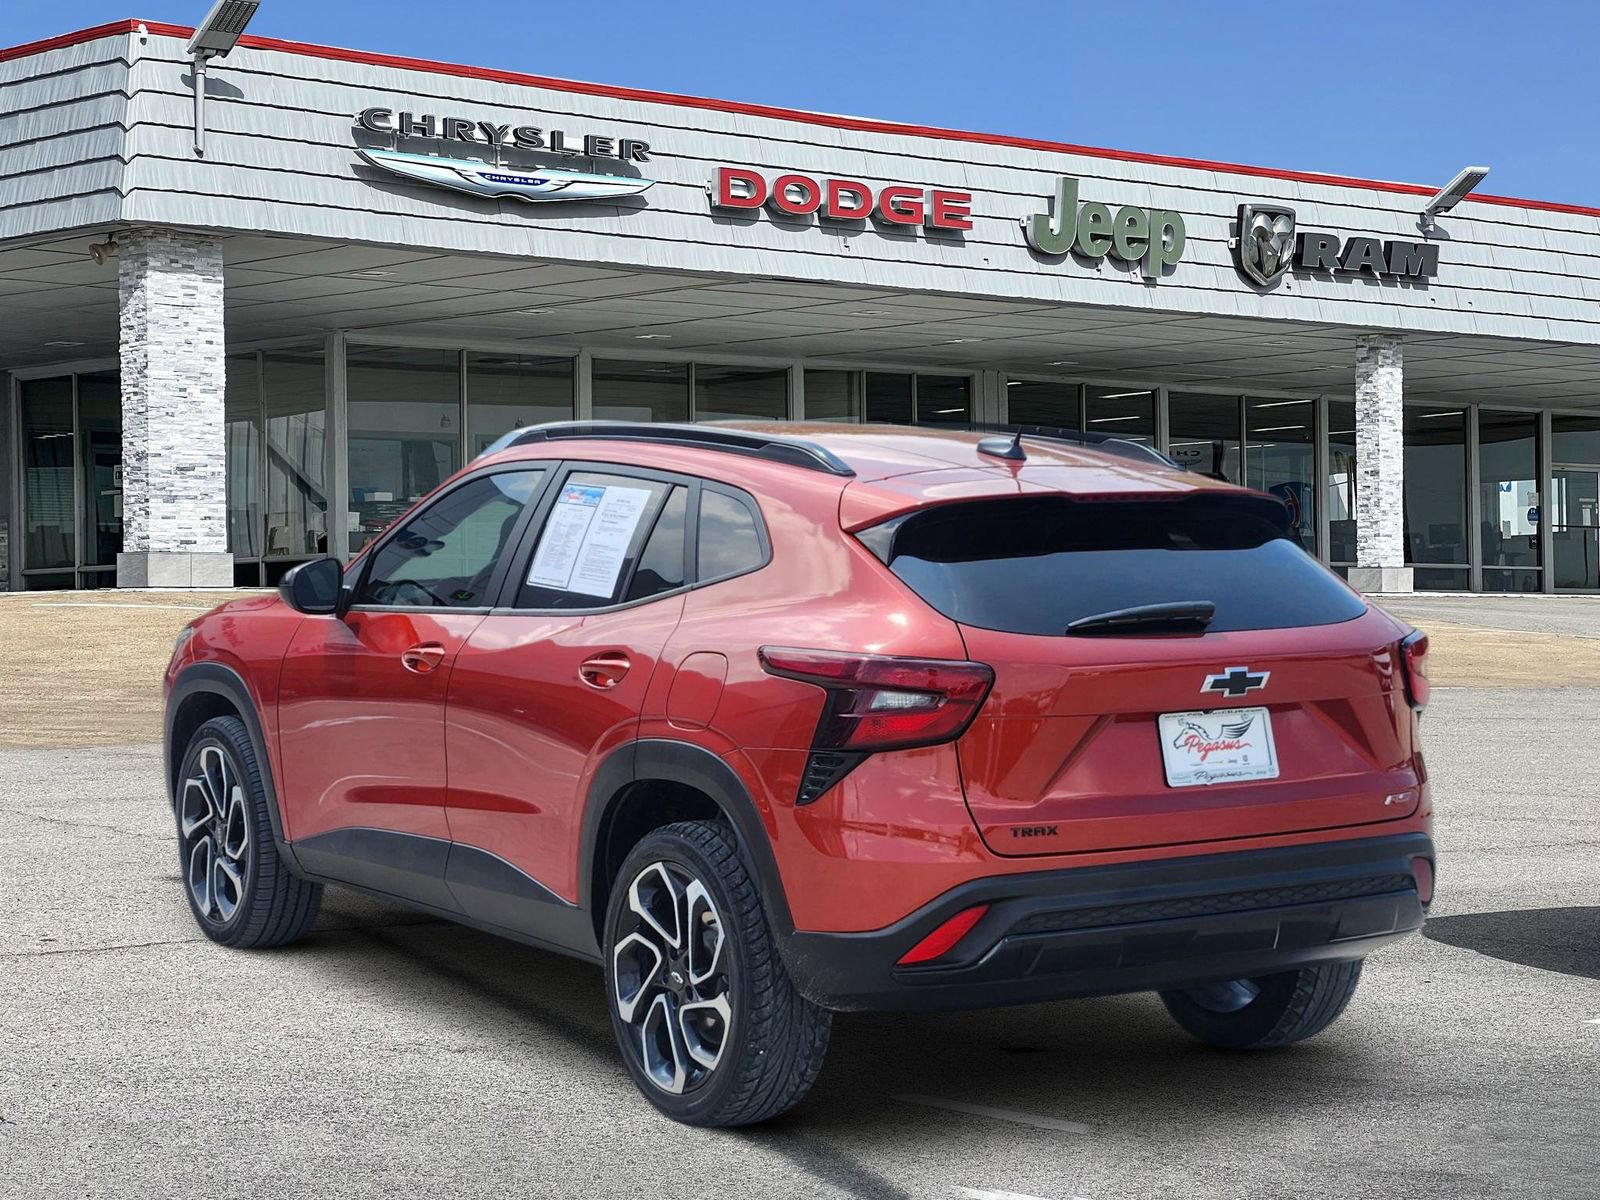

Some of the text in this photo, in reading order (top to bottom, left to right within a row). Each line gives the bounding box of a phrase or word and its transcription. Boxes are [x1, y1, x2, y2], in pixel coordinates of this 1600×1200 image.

[357, 107, 651, 163] CHRYSLER
[484, 174, 541, 185] CHRYSLER
[712, 166, 974, 231] DODGE
[1024, 177, 1187, 278] Jeep
[1296, 232, 1440, 278] RAM
[1184, 734, 1252, 763] Pegasus
[1010, 825, 1059, 838] TRAX
